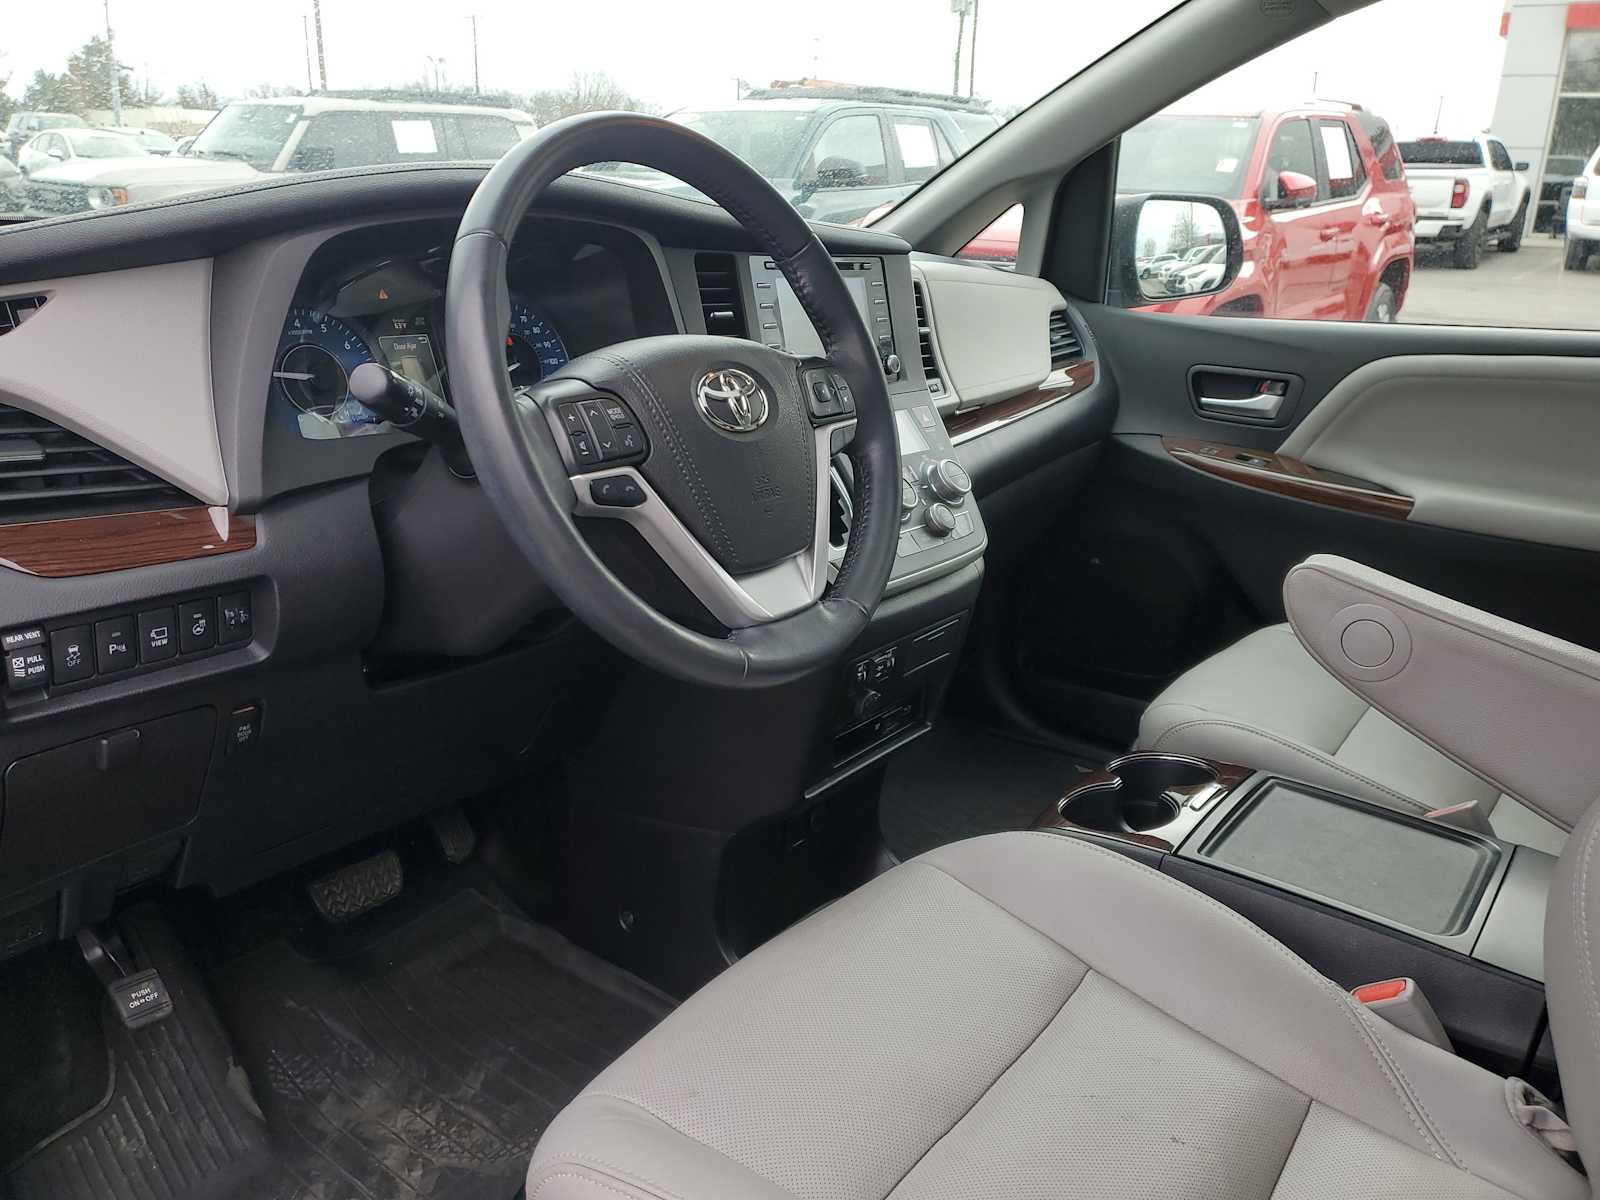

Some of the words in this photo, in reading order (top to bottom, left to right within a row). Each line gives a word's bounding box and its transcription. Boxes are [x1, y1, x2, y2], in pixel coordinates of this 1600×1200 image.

[320, 323, 328, 334] 5
[344, 340, 351, 350] 6
[6, 634, 24, 643] REAR
[24, 631, 41, 639] VENT
[151, 638, 168, 647] VIEW
[26, 654, 43, 664] PULL
[28, 665, 45, 674] PUSH
[131, 988, 151, 999] PUSH
